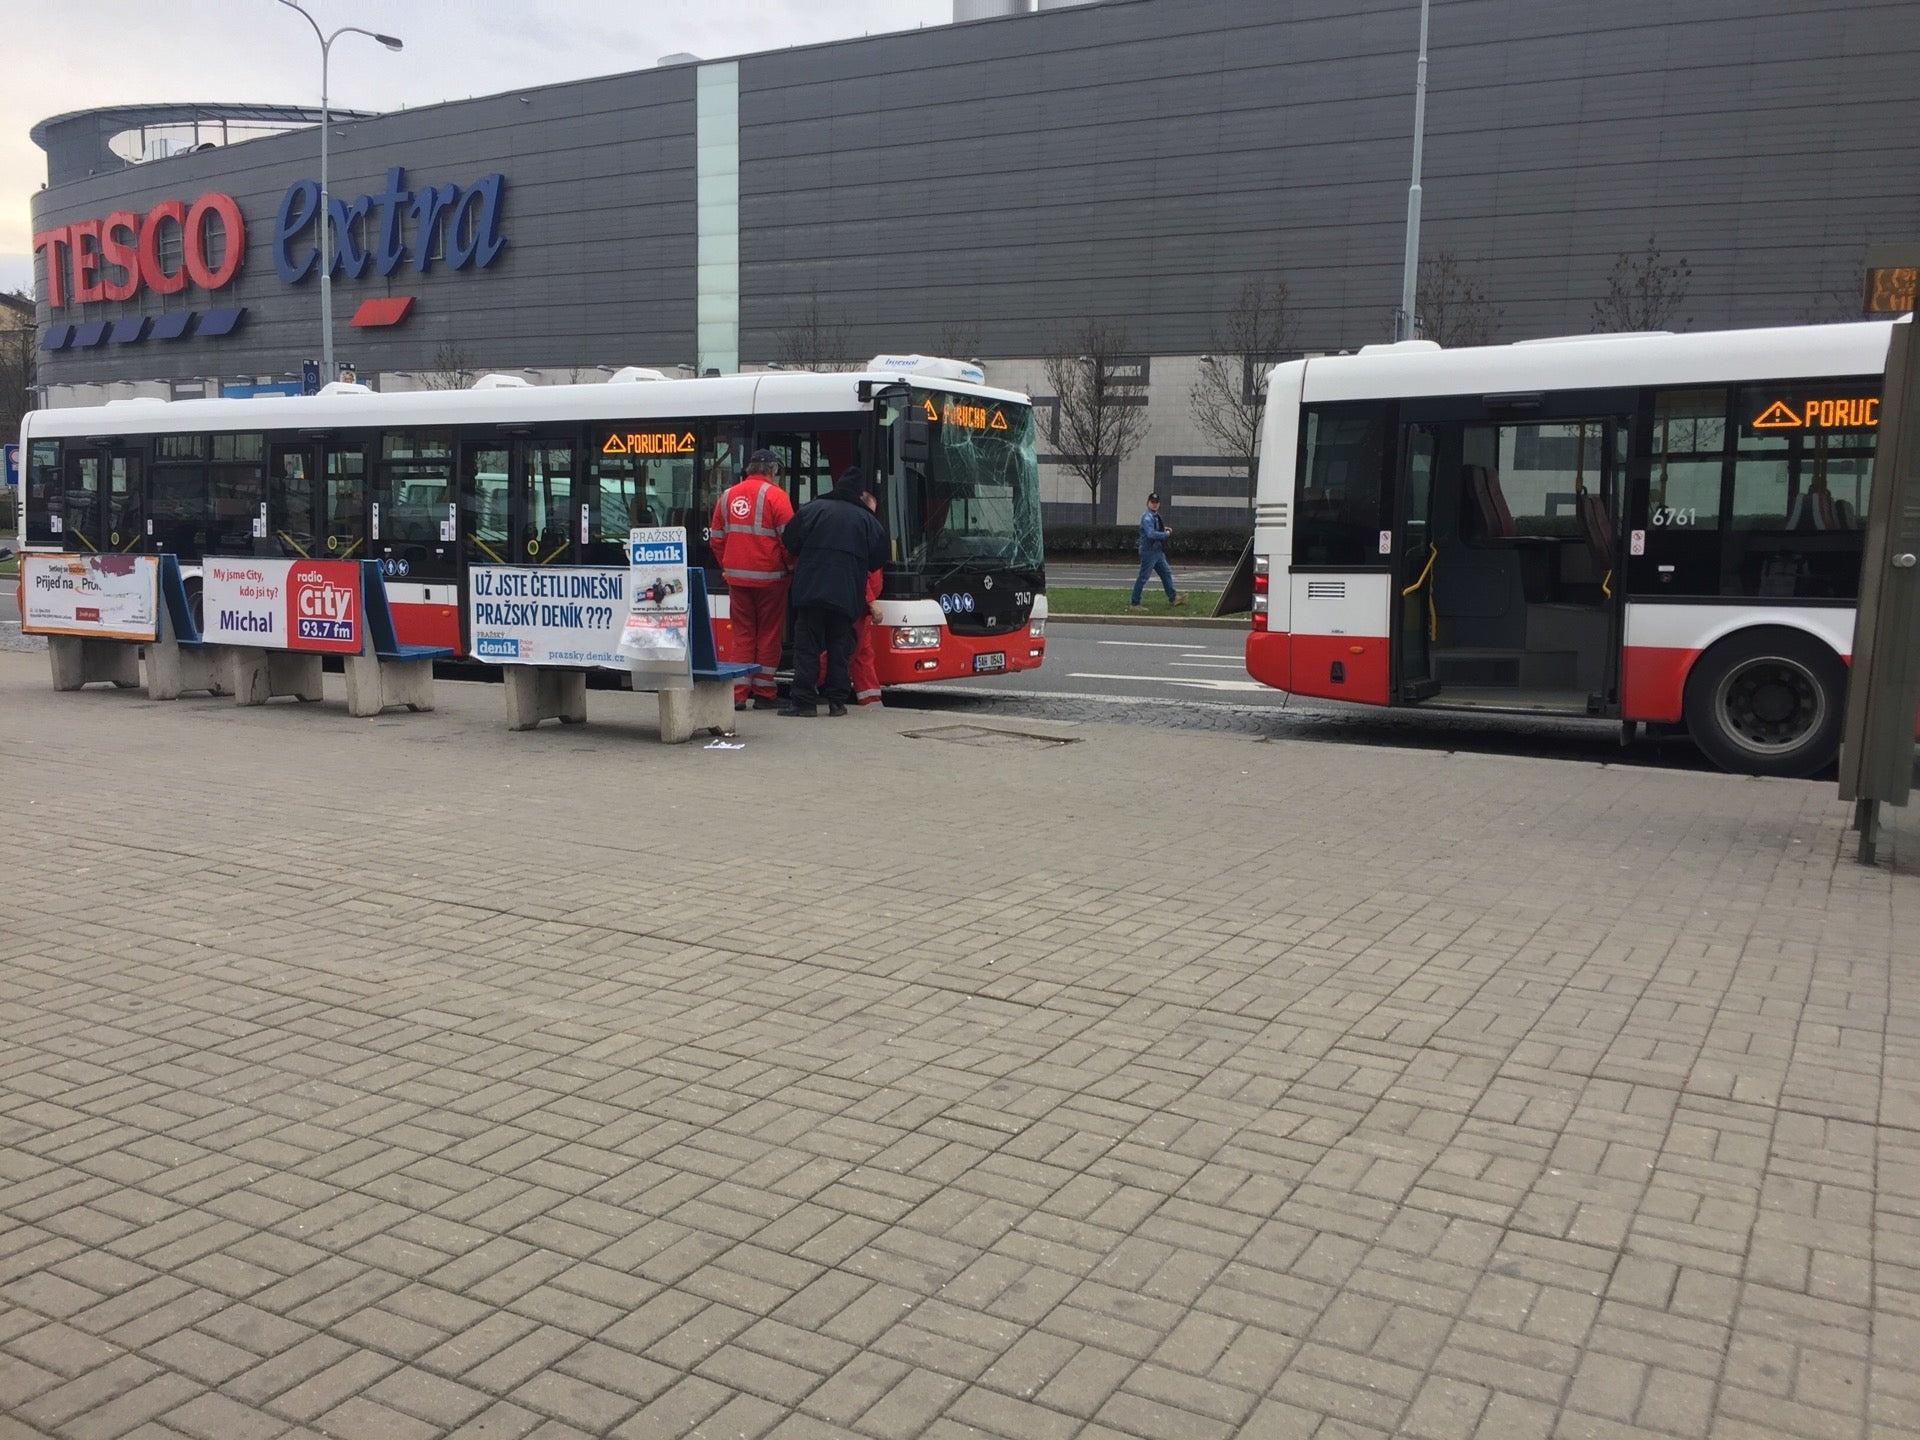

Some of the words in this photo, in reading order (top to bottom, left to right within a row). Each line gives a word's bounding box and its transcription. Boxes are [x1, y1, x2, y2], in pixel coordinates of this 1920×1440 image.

[33, 192, 245, 307] TESCO
[272, 167, 509, 284] extra
[627, 433, 677, 454] PORUCHA
[1652, 507, 1696, 526] 6761
[632, 529, 683, 543] PRAŽSKÝ
[635, 545, 681, 562] deník
[36, 575, 62, 591] Přijeď
[62, 579, 74, 589] na
[213, 568, 225, 581] My
[226, 569, 245, 582] jsme
[246, 570, 264, 582] City,
[297, 571, 323, 583] radio
[239, 586, 255, 597] kdo
[255, 587, 265, 600] jsi
[266, 588, 279, 600] ty?
[475, 570, 493, 596] UŽ
[495, 574, 528, 597] JSTE
[531, 571, 569, 598] ČETLI
[571, 573, 623, 600] DNEŠNÍ
[1014, 591, 1031, 606] 3747
[220, 610, 273, 633] Michal
[476, 600, 539, 626] PRAŽSKÝ
[542, 602, 584, 628] DENÍK
[586, 606, 613, 630] ???
[902, 615, 908, 624] 4
[302, 621, 331, 637] 93.7
[333, 624, 350, 639] fm
[479, 640, 517, 655] deník
